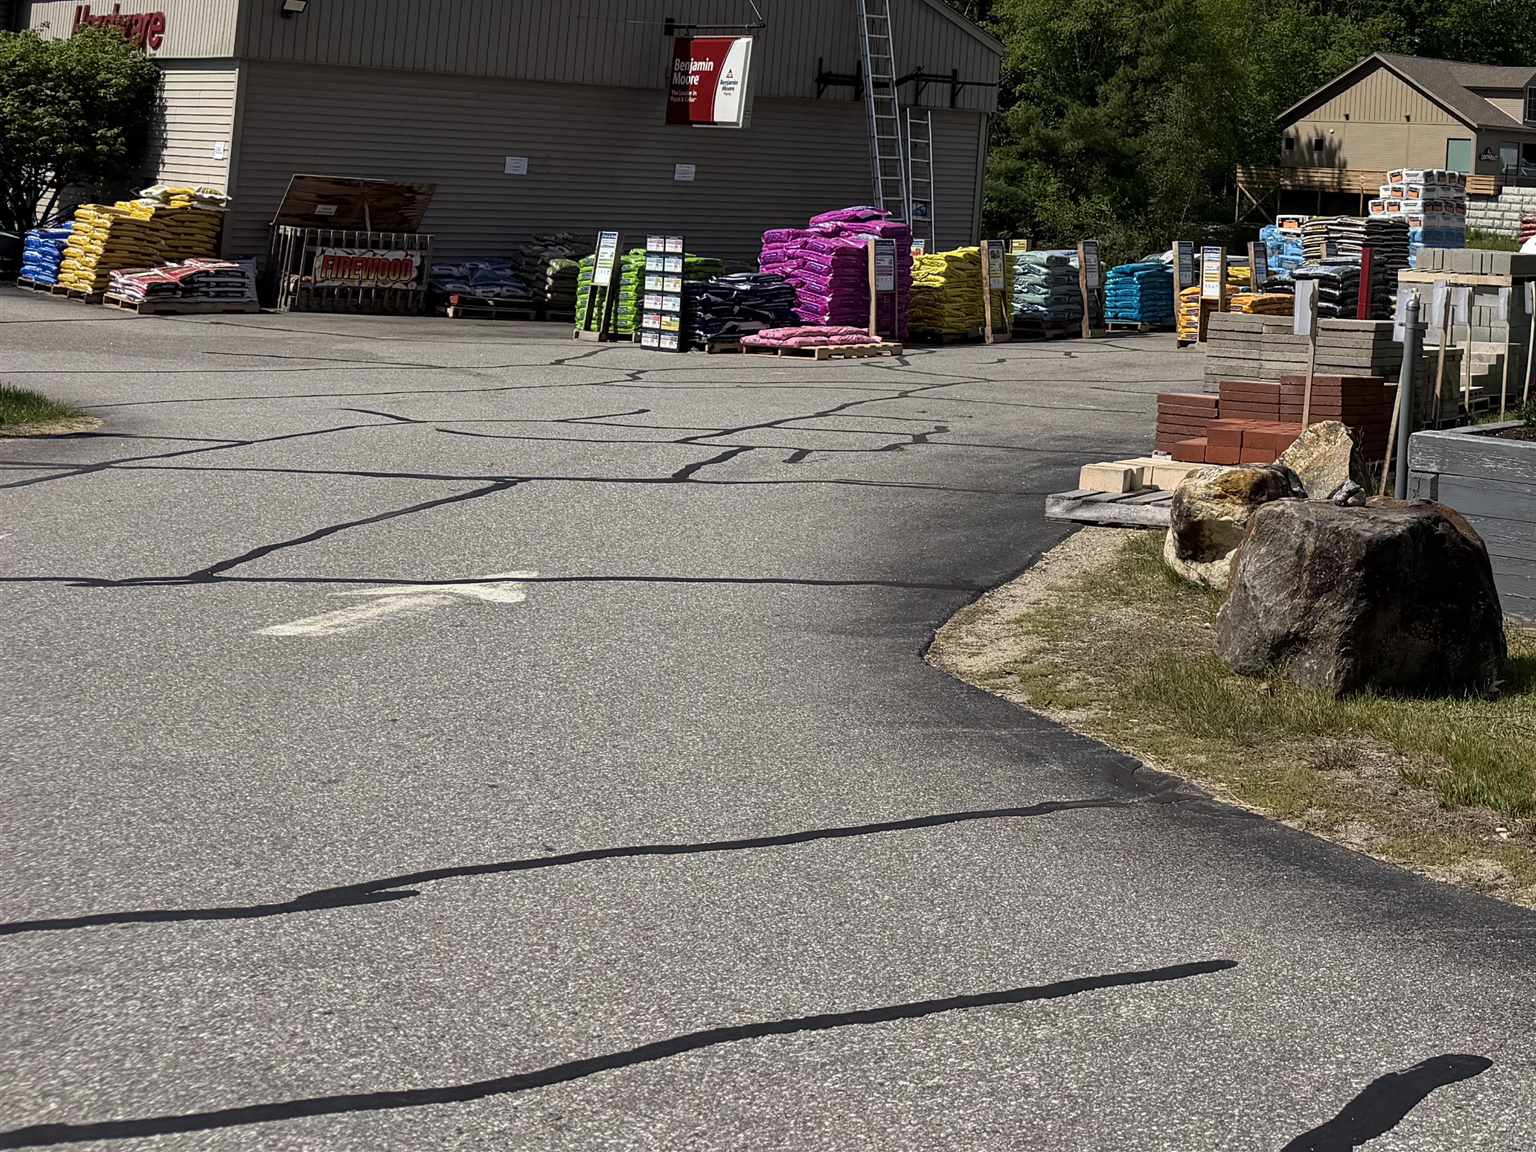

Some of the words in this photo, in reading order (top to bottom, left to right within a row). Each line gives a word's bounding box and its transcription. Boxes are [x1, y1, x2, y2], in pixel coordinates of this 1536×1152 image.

[674, 57, 714, 74] Benjamin
[672, 72, 700, 85] Moore
[320, 254, 416, 282] FIREWOOD
